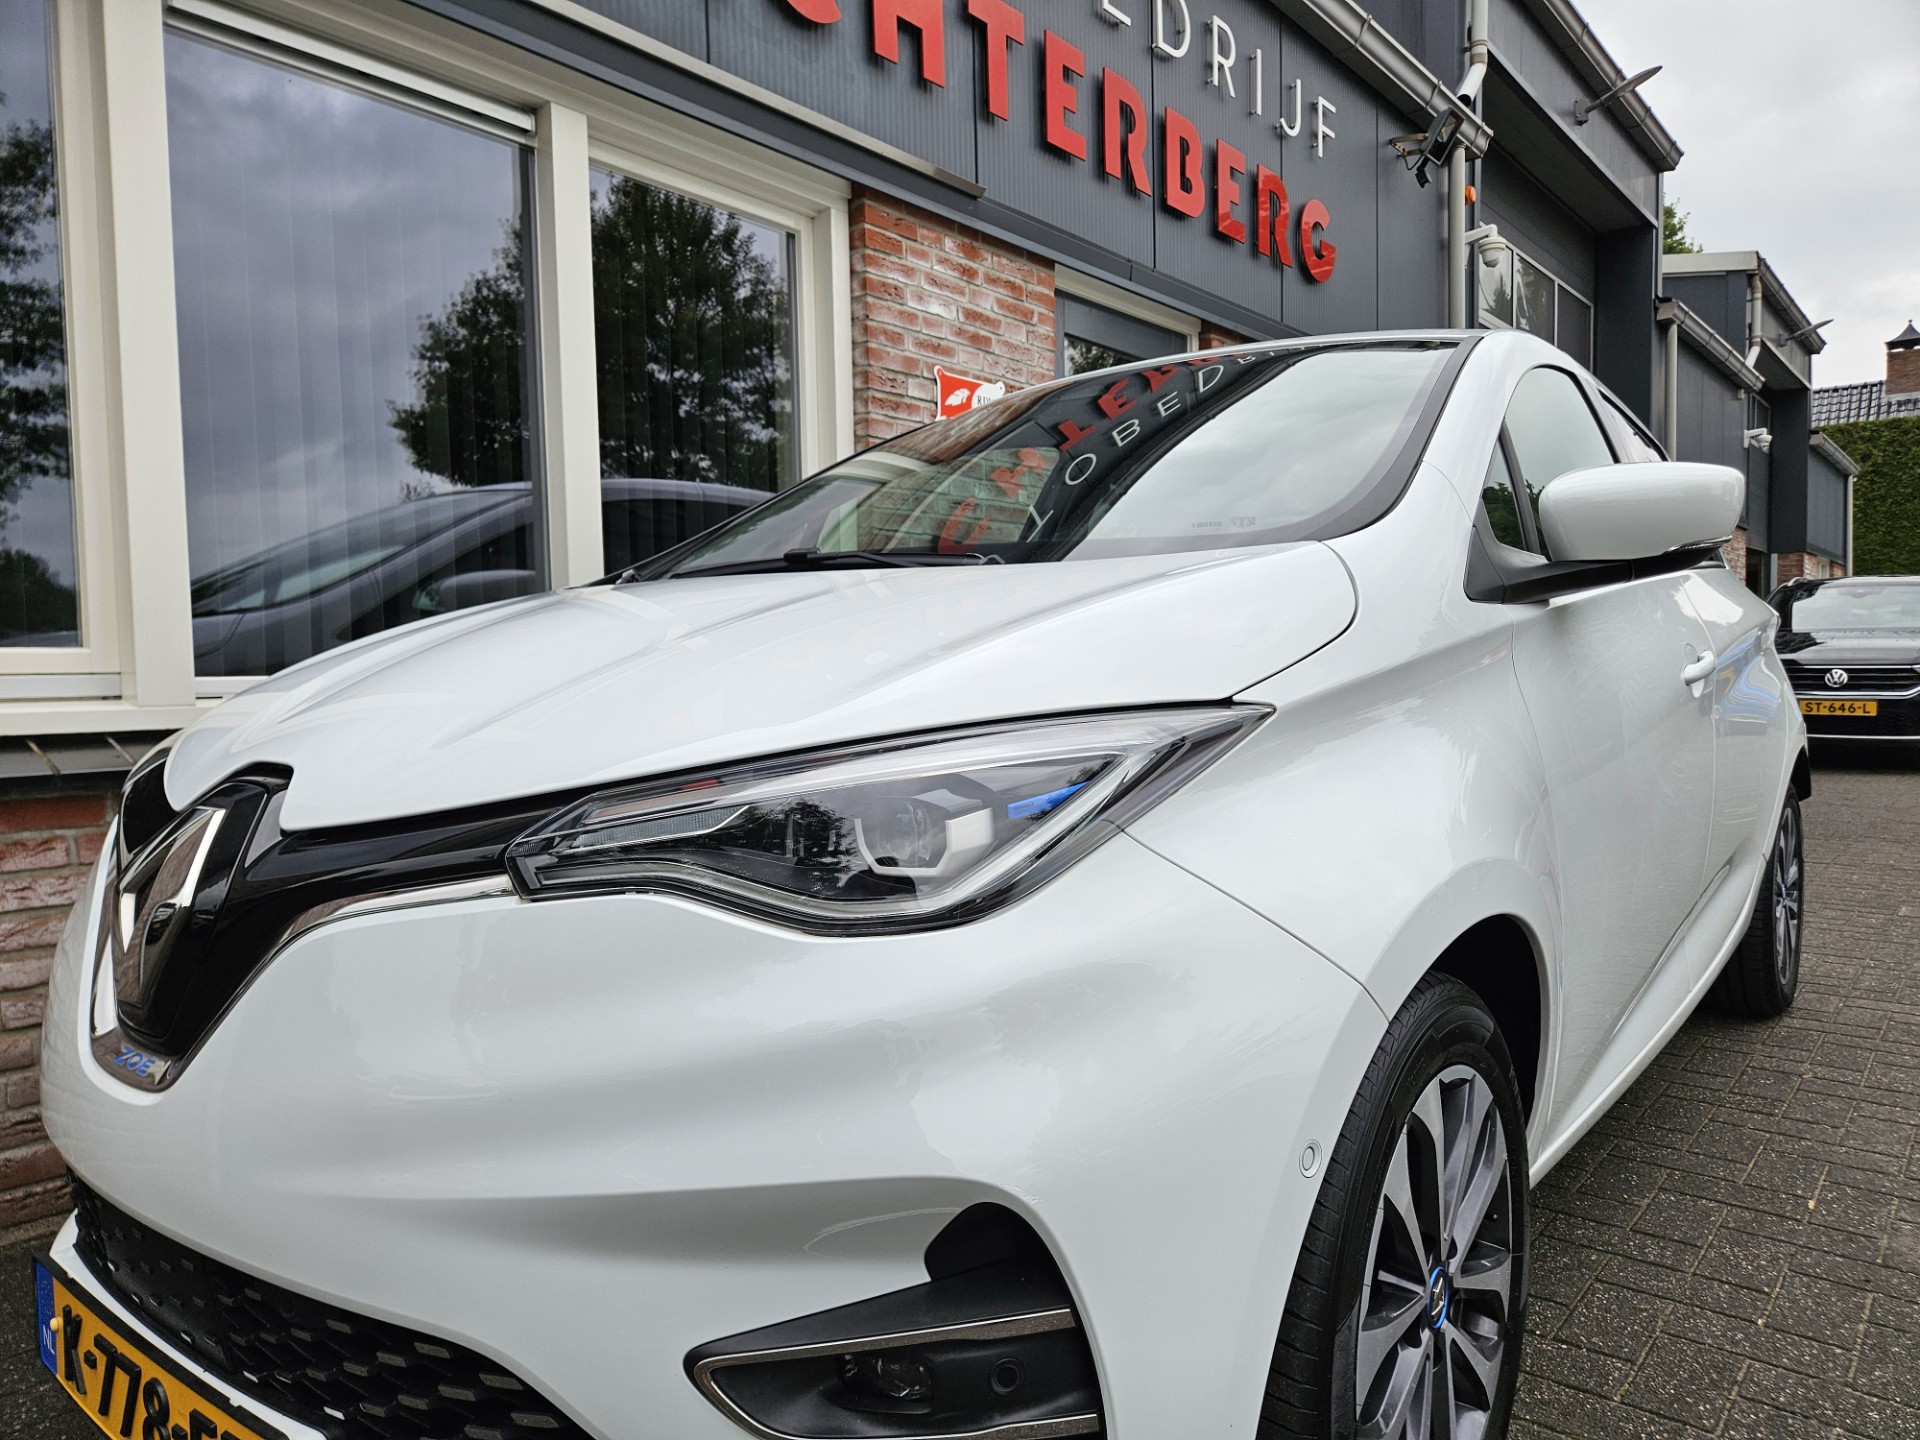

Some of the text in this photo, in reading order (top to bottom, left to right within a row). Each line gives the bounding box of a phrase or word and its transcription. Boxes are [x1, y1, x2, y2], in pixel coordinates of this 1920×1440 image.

[786, 0, 1337, 283] HTERBERG
[977, 395, 992, 405] RD
[1805, 702, 1871, 714] ST-646-L
[114, 1045, 157, 1077] ZOE
[42, 1324, 55, 1355] NL
[62, 1304, 241, 1440] K-778-
